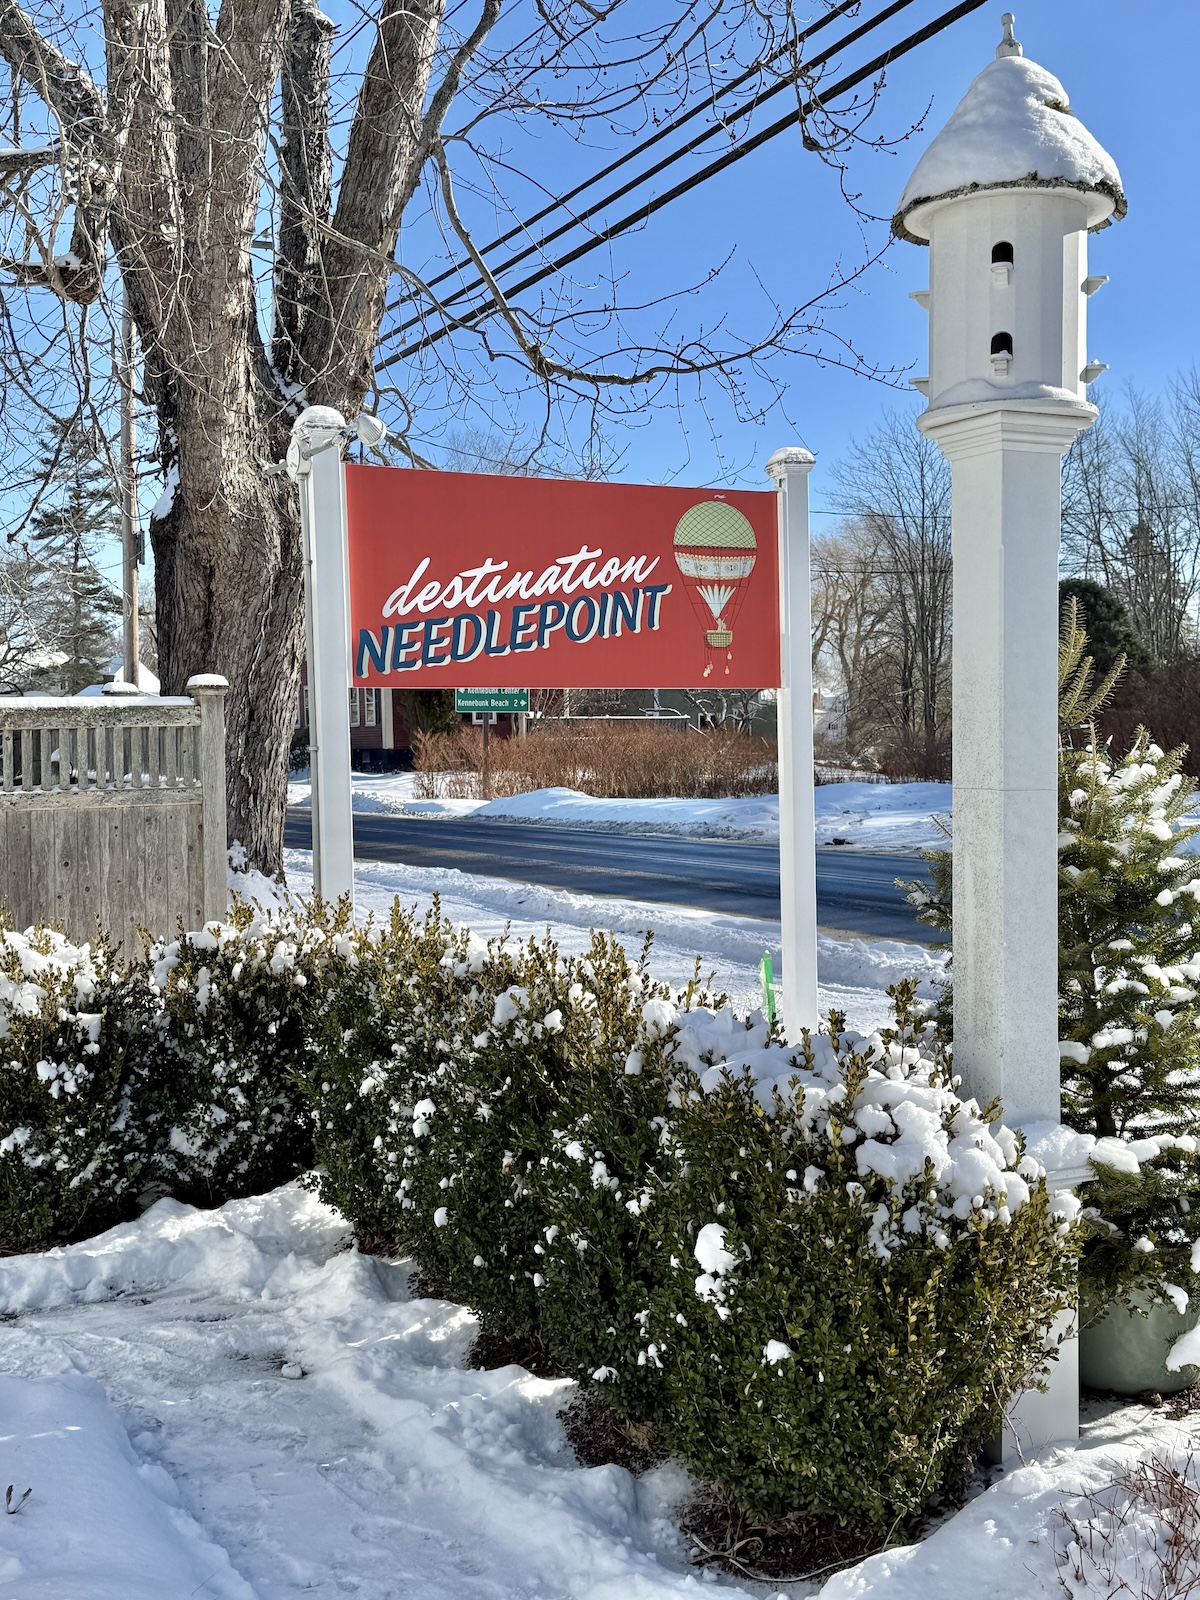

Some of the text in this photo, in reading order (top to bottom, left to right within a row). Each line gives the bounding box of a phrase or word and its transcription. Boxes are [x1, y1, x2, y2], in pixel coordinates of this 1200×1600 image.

[382, 544, 661, 618] destination
[356, 583, 673, 678] NEEDLEPOINT
[457, 699, 518, 707] Kennebunk Beach 2
